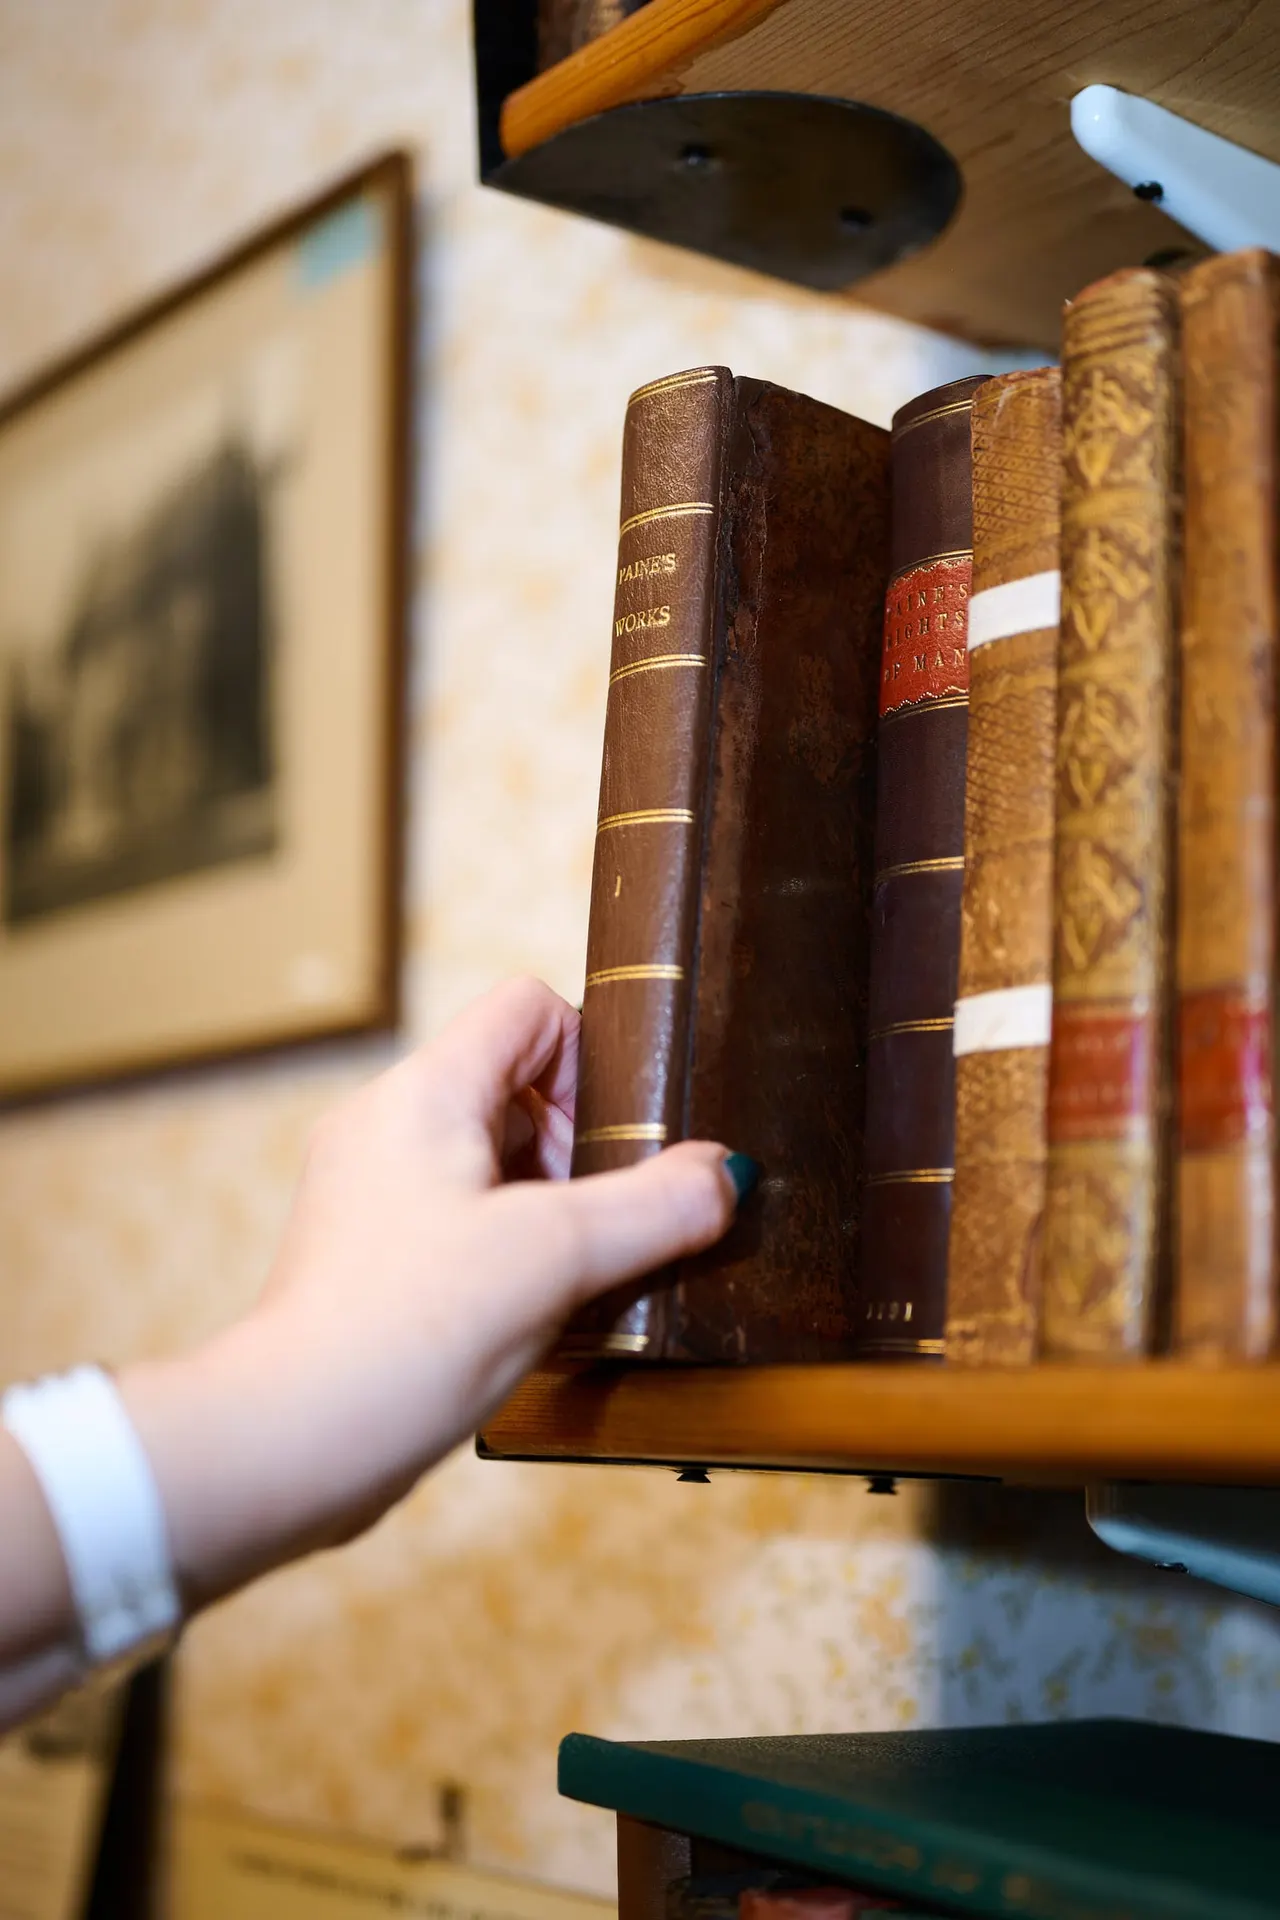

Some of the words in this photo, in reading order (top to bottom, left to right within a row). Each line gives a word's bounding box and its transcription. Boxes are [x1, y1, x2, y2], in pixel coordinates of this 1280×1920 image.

[619, 553, 675, 584] PAINE'S
[615, 605, 671, 637] WORKS
[884, 661, 901, 682] OF
[914, 647, 967, 673] MAN
